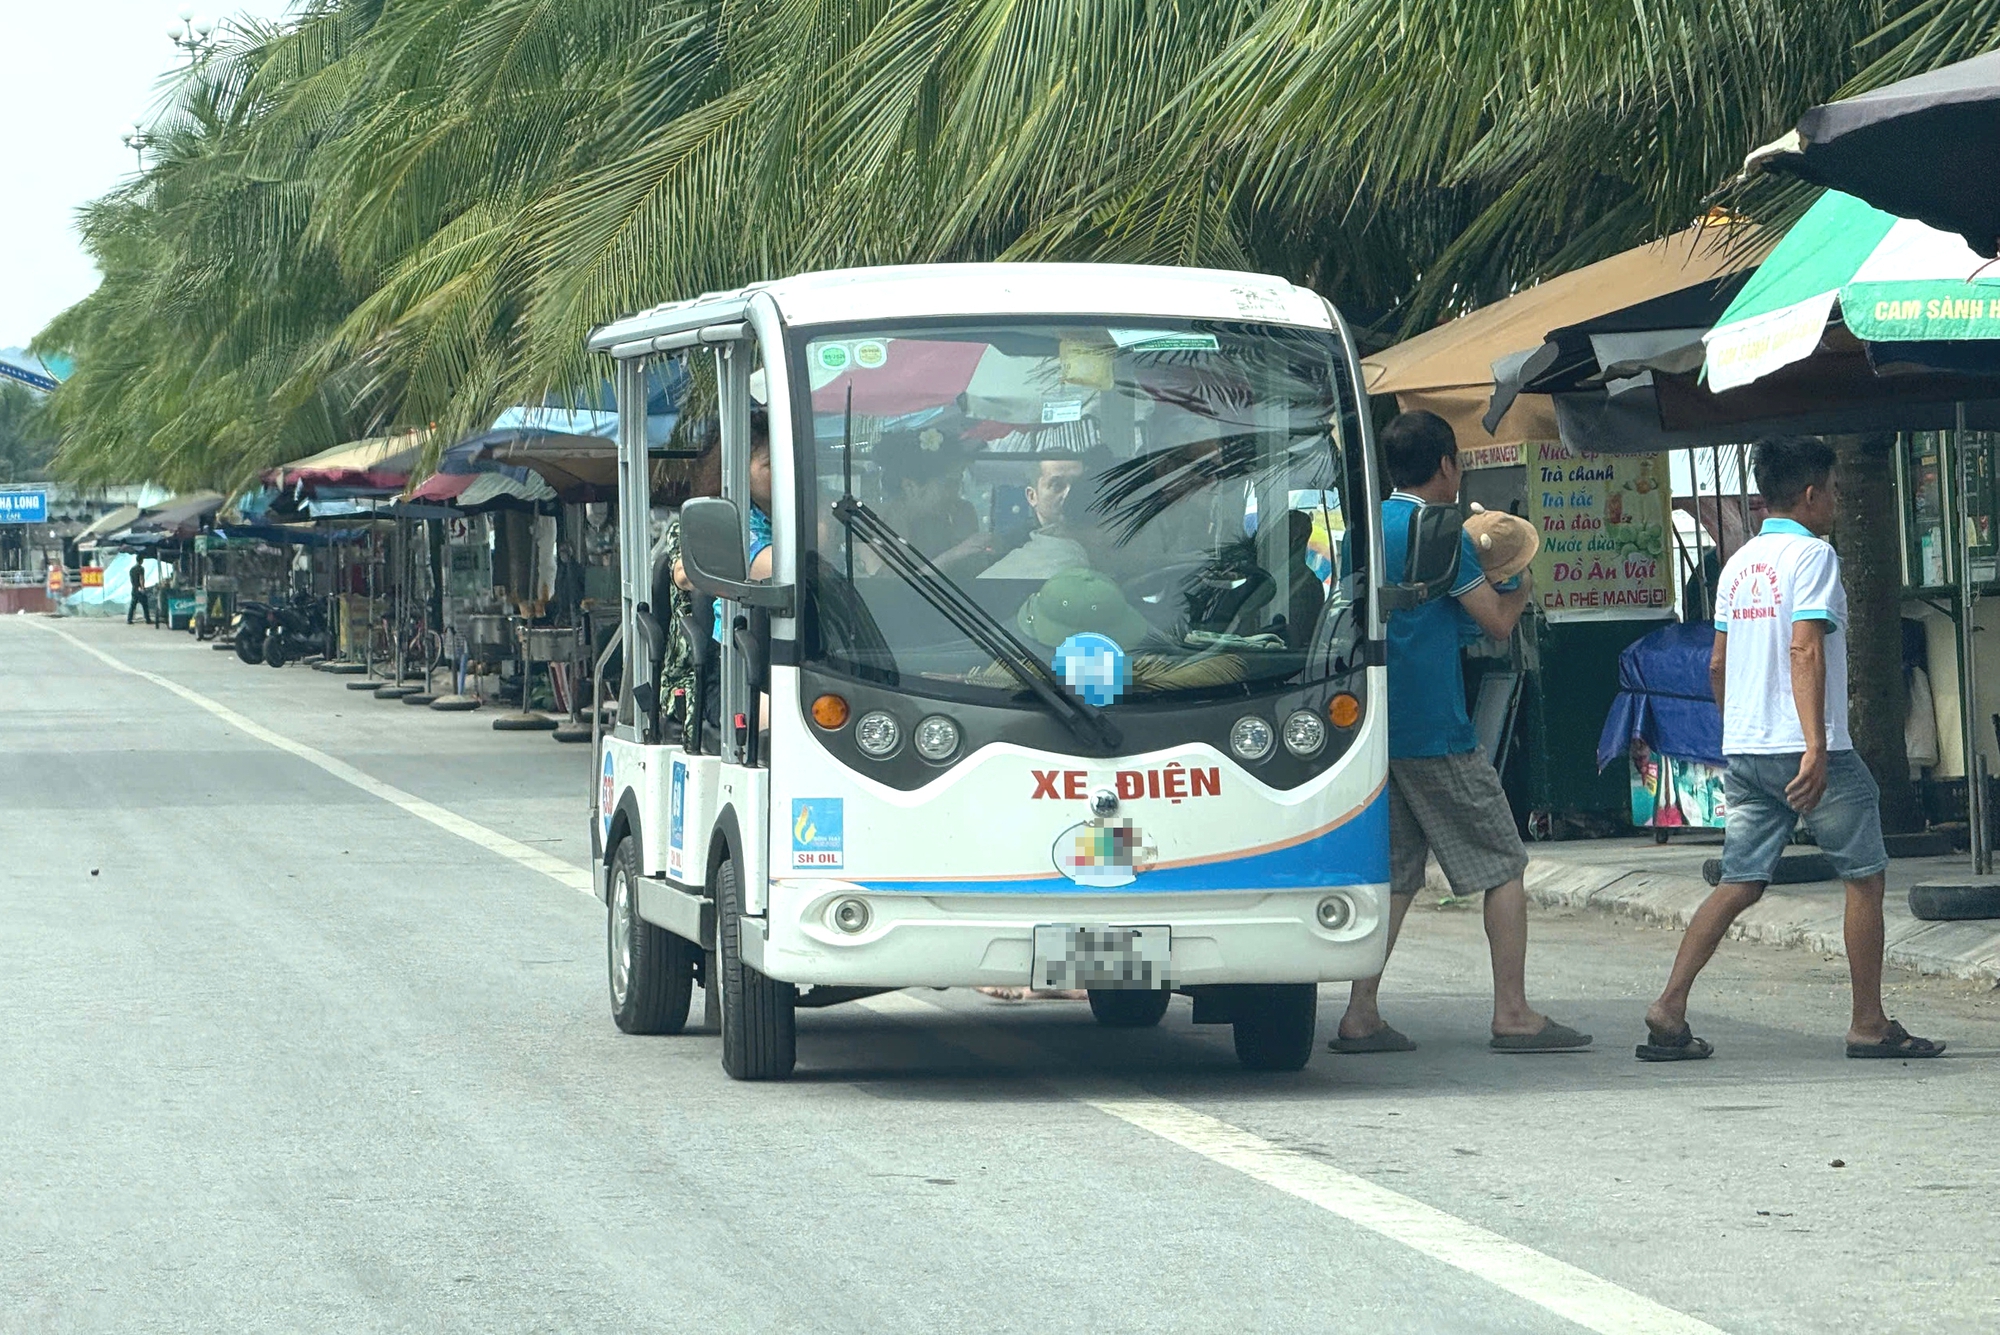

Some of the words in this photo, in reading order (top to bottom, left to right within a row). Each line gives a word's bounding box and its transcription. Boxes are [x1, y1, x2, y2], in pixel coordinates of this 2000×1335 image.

[1874, 300, 1921, 320] CAM
[1926, 295, 1983, 319] SÀNH
[1541, 465, 1563, 482] Trà
[1569, 465, 1613, 481] chanh
[14, 495, 39, 510] LONG
[1542, 491, 1564, 508] Trà
[1570, 486, 1593, 508] tắc
[1543, 514, 1565, 531] Trà
[1571, 513, 1602, 530] đào
[1544, 535, 1582, 553] Nước
[1588, 534, 1615, 552] dừa
[1553, 558, 1583, 582] Đồ
[1588, 556, 1617, 580] Ăn
[1624, 559, 1656, 585] Vặt
[1544, 589, 1565, 608] CÀ
[1569, 588, 1599, 607] PHÊ
[1603, 589, 1648, 605] MANG
[1652, 588, 1667, 605] ĐI
[1031, 770, 1088, 799] XE
[1115, 762, 1221, 804] ĐIỆN
[798, 853, 814, 863] SH
[818, 853, 838, 863] OIL
